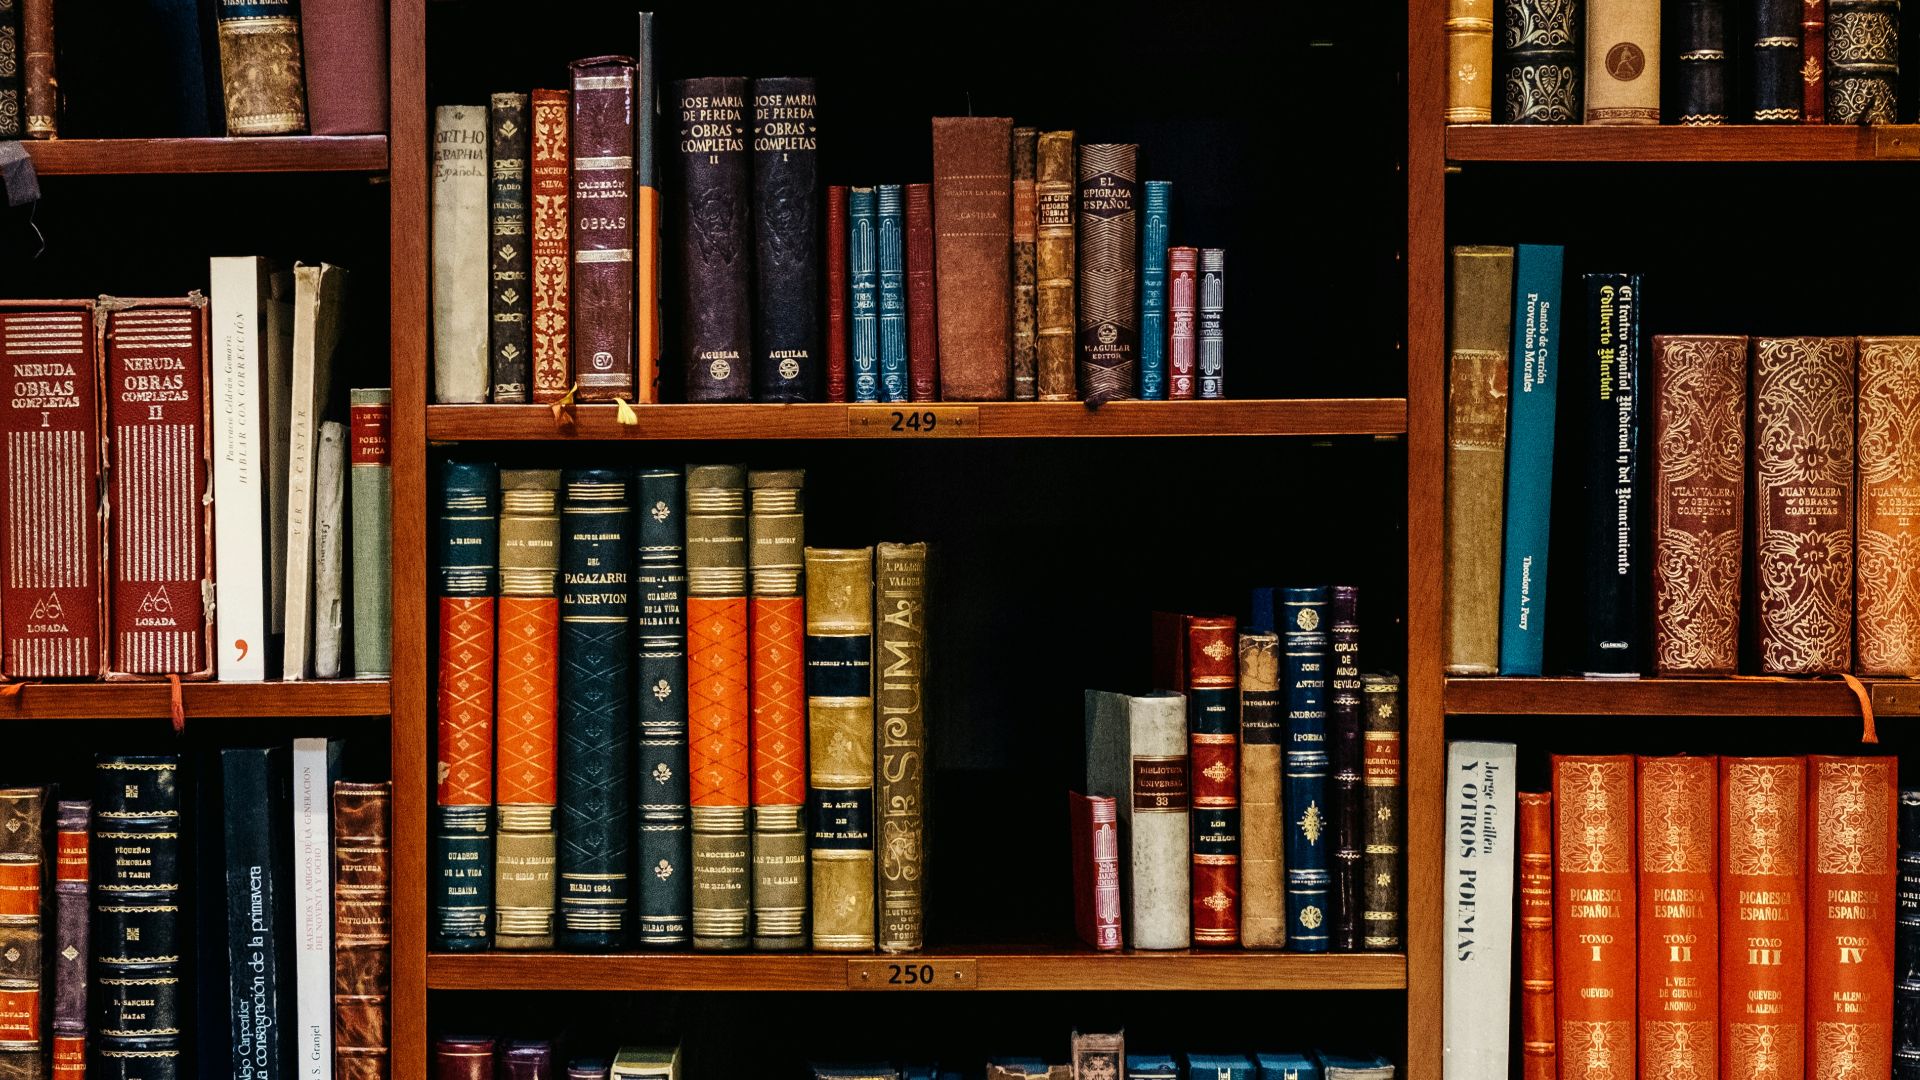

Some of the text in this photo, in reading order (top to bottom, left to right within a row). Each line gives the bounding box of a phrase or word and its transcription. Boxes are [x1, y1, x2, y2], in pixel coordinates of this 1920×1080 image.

[681, 96, 743, 108] JOSE MARIA
[754, 95, 816, 106] JOSE MARIA
[683, 109, 742, 121] DE PEREDA
[756, 108, 814, 119] DE PEREDA
[692, 124, 732, 138] OBRAS
[765, 123, 804, 135] OBRAS
[681, 139, 743, 152] COMPLETAS
[755, 138, 816, 150] COMPLETAS
[710, 156, 718, 164] II
[783, 154, 788, 162] I
[1100, 178, 1114, 187] EL
[1083, 189, 1131, 198] EPIGRAMA
[1083, 197, 1130, 209] ESPAÑOL
[581, 218, 626, 230] OBRAS
[1524, 293, 1538, 392] Proverbios Morales
[1537, 302, 1549, 384] Santob de Carrión
[1598, 285, 1614, 400] Edilberto Marbán
[700, 351, 740, 360] AGUILAR
[769, 350, 808, 358] AGUILAR
[13, 363, 76, 376] NERUDA
[123, 357, 185, 371] NERUDA
[124, 375, 183, 390] OBRAS
[14, 381, 74, 397] OBRAS
[122, 390, 189, 402] COMPLETAS
[234, 312, 247, 484] HABLAR CON CORRECCIÓN
[12, 397, 80, 408] COMPLETAS
[148, 405, 163, 420] II
[41, 412, 50, 427] I
[891, 411, 937, 432] 249
[1616, 285, 1632, 574] El teatro español Medieval del Renacimiento
[297, 410, 305, 473] CANTAR
[1672, 487, 1735, 497] JUAN VALERA
[1779, 487, 1841, 496] JUAN VALERA
[1870, 488, 1896, 497] JUAN
[1678, 507, 1731, 515] COMPLETAS
[1784, 507, 1838, 515] COMPLETAS
[294, 508, 302, 535] VER
[564, 573, 626, 584] PAGAZARRI
[563, 594, 627, 604] AL NERVION
[1519, 556, 1531, 630] Theodore A. Perry
[664, 604, 680, 612] VIDA
[135, 617, 176, 626] LOSADA
[28, 624, 68, 632] LOSADA
[1335, 643, 1358, 652] COPLAS
[1336, 668, 1357, 676] MINGO
[1334, 680, 1360, 689] REVULGO
[883, 600, 921, 816] ESPUMA
[1369, 766, 1397, 774] ESPAÑOL
[304, 766, 312, 824] GENERACION
[1156, 796, 1168, 806] 33
[1481, 761, 1499, 854] Jorge Guillén
[304, 828, 311, 839] LA
[304, 840, 312, 852] DE
[1458, 761, 1478, 961] Y OTROS POEMAS
[467, 869, 483, 877] VIDA
[448, 886, 478, 895] BILBAINA
[570, 884, 591, 892] BILBAO
[306, 894, 312, 902] Y
[1571, 889, 1622, 901] PICARESCA
[1654, 889, 1704, 901] PICARESCA
[1740, 891, 1791, 905] PICARESCA
[1828, 890, 1878, 903] PICARESCA
[1571, 904, 1620, 918] ESPAÑOLA
[1655, 904, 1703, 918] ESPAÑOLA
[1741, 907, 1789, 920] ESPAÑOLA
[1829, 906, 1877, 919] ESPAÑOLA
[1580, 934, 1613, 944] TOMO
[1664, 934, 1696, 944] TOMO
[1748, 938, 1782, 947] TOMO
[1836, 936, 1869, 946] TOMO
[1592, 946, 1601, 961] I
[1670, 946, 1692, 962] II
[1748, 949, 1782, 965] III
[1840, 948, 1867, 963] IV
[248, 866, 272, 1066] consagración de la primavera
[888, 964, 934, 984] 250
[1674, 977, 1696, 986] VELEZ
[1581, 988, 1613, 998] QUEVEDO
[1659, 989, 1702, 998] DE GUEVARA
[1748, 990, 1781, 1000] QUEVEDO
[1664, 1002, 1696, 1011] ANONIMO
[238, 999, 254, 1055] Carpentier
[311, 1025, 322, 1060] Granjel
